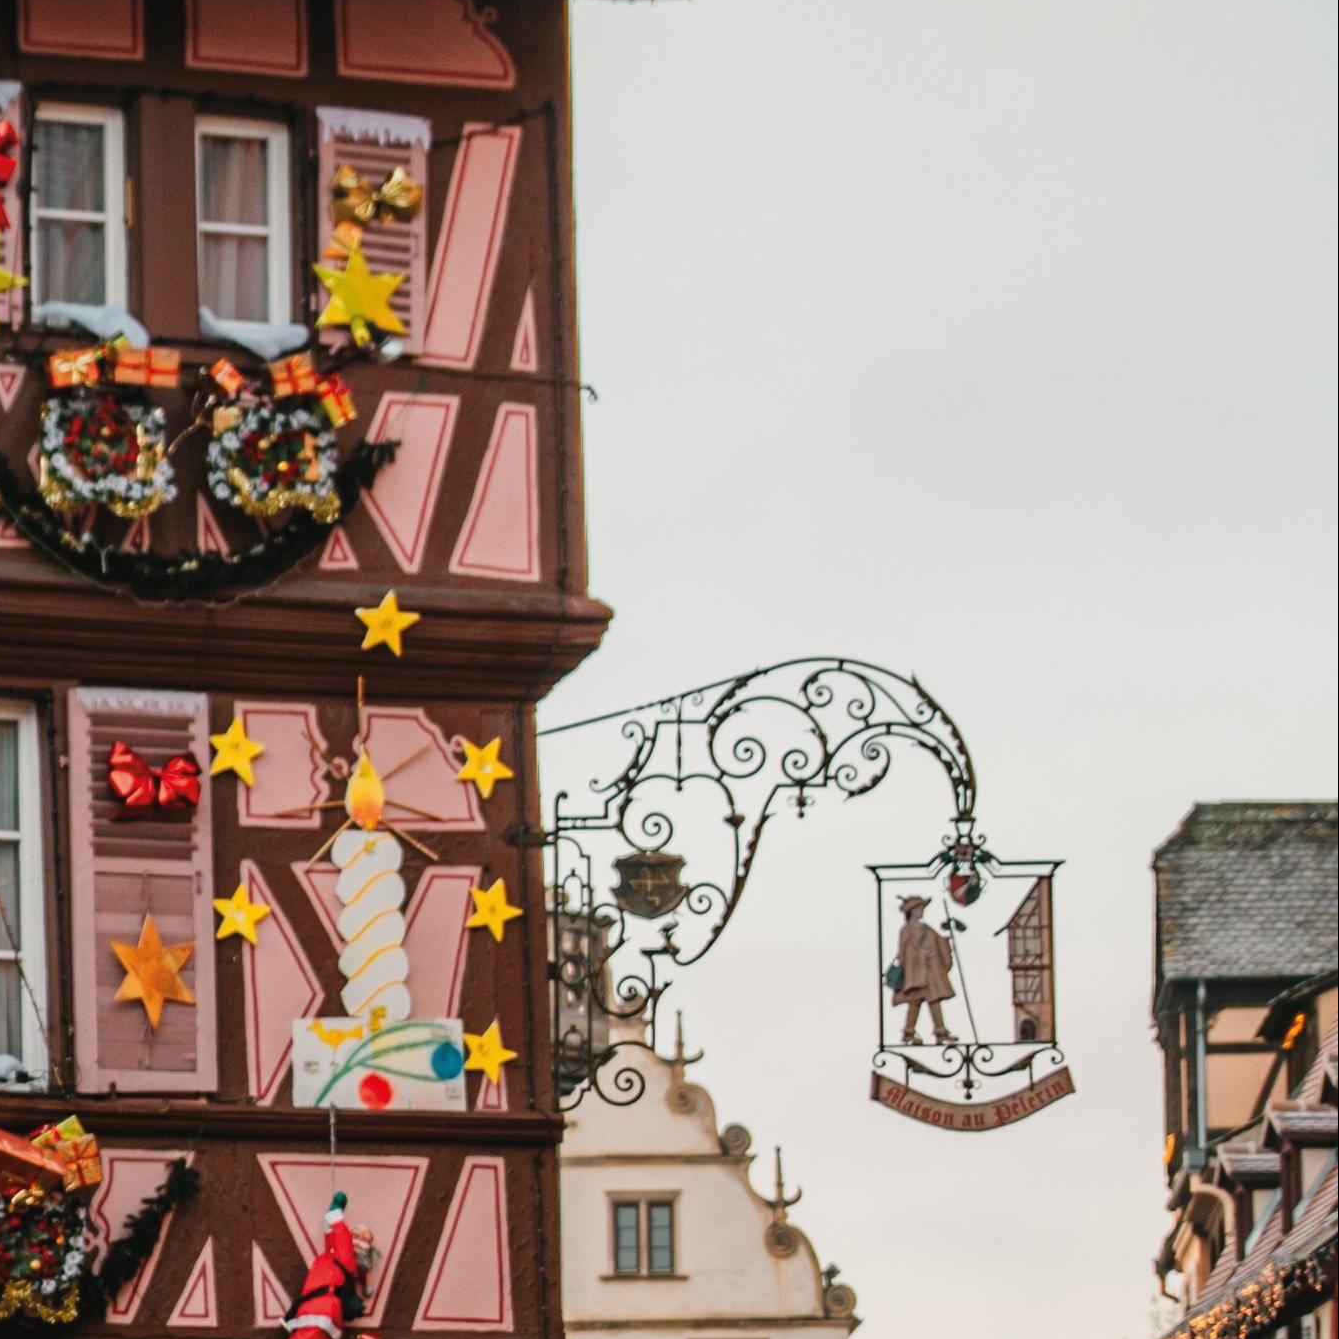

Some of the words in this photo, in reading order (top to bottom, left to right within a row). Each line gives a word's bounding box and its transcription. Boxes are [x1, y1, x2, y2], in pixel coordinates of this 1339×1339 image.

[883, 1085, 954, 1127] Maison
[961, 1113, 986, 1127] au
[991, 1080, 1065, 1125] Pélerin
